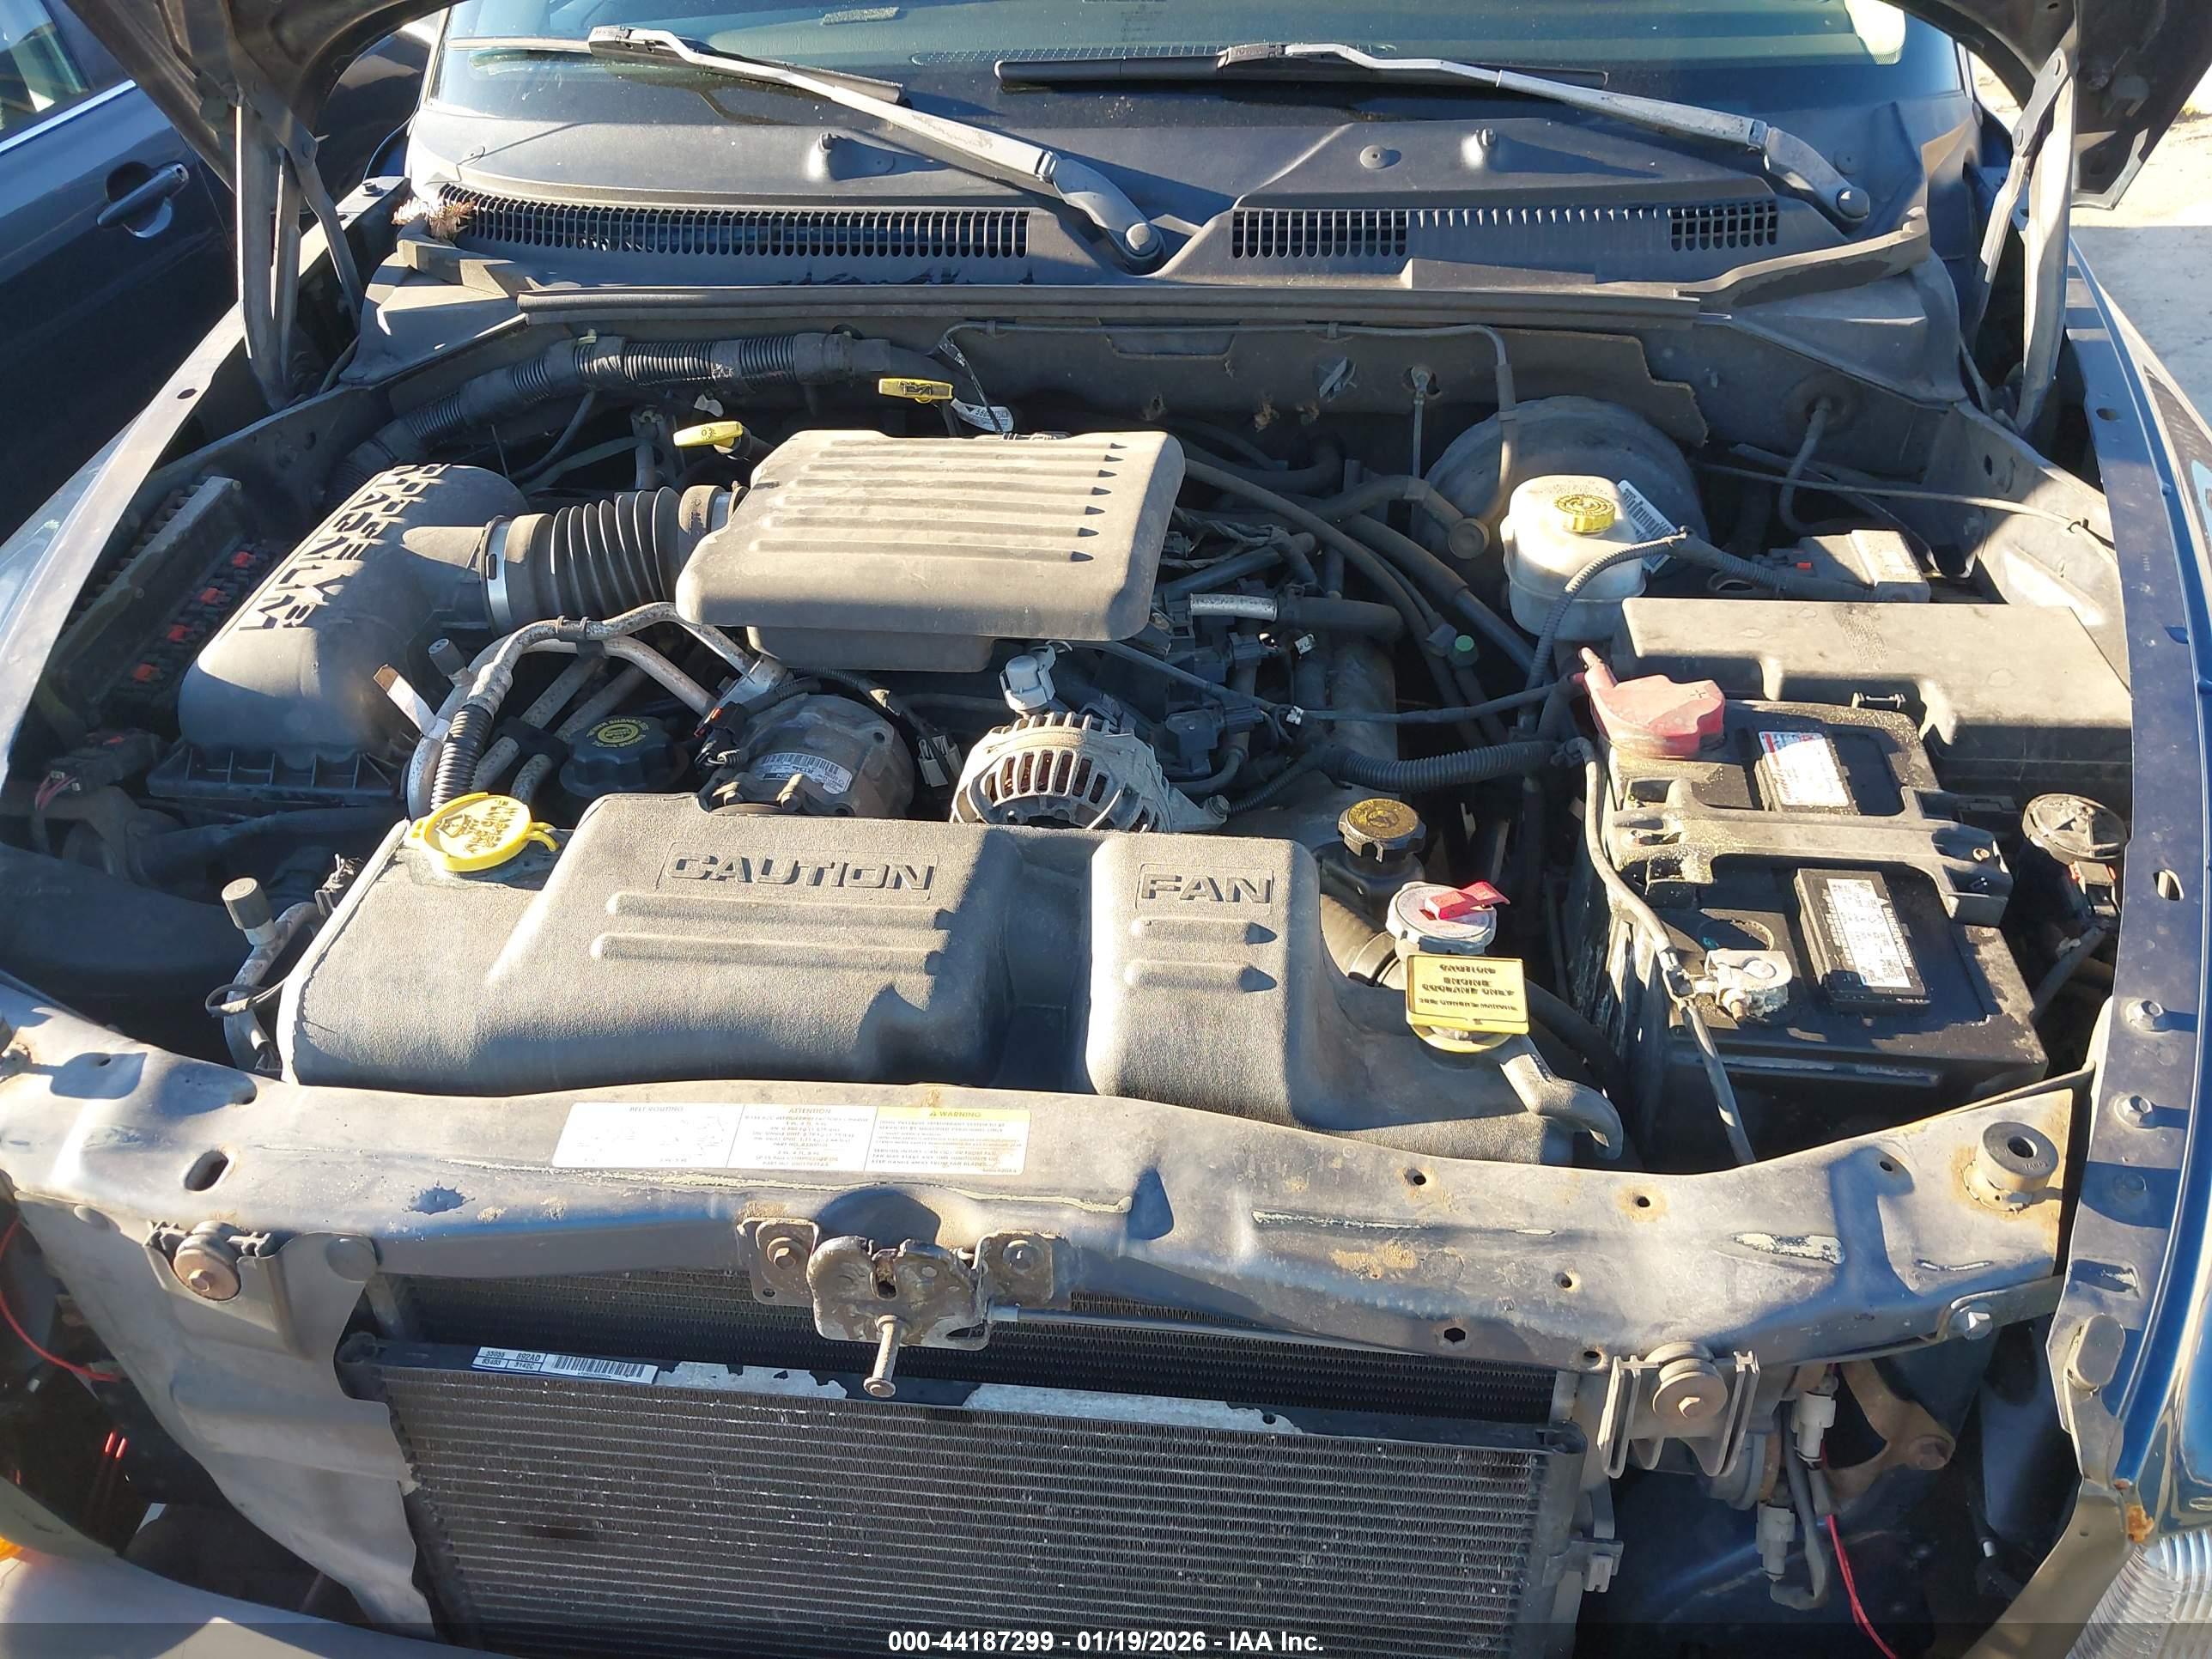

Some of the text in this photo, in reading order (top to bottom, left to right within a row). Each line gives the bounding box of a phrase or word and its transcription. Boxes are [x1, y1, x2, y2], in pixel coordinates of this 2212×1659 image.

[239, 465, 420, 630] MAGNUM
[667, 853, 935, 890] CAUTION
[1141, 874, 1271, 903] FAN
